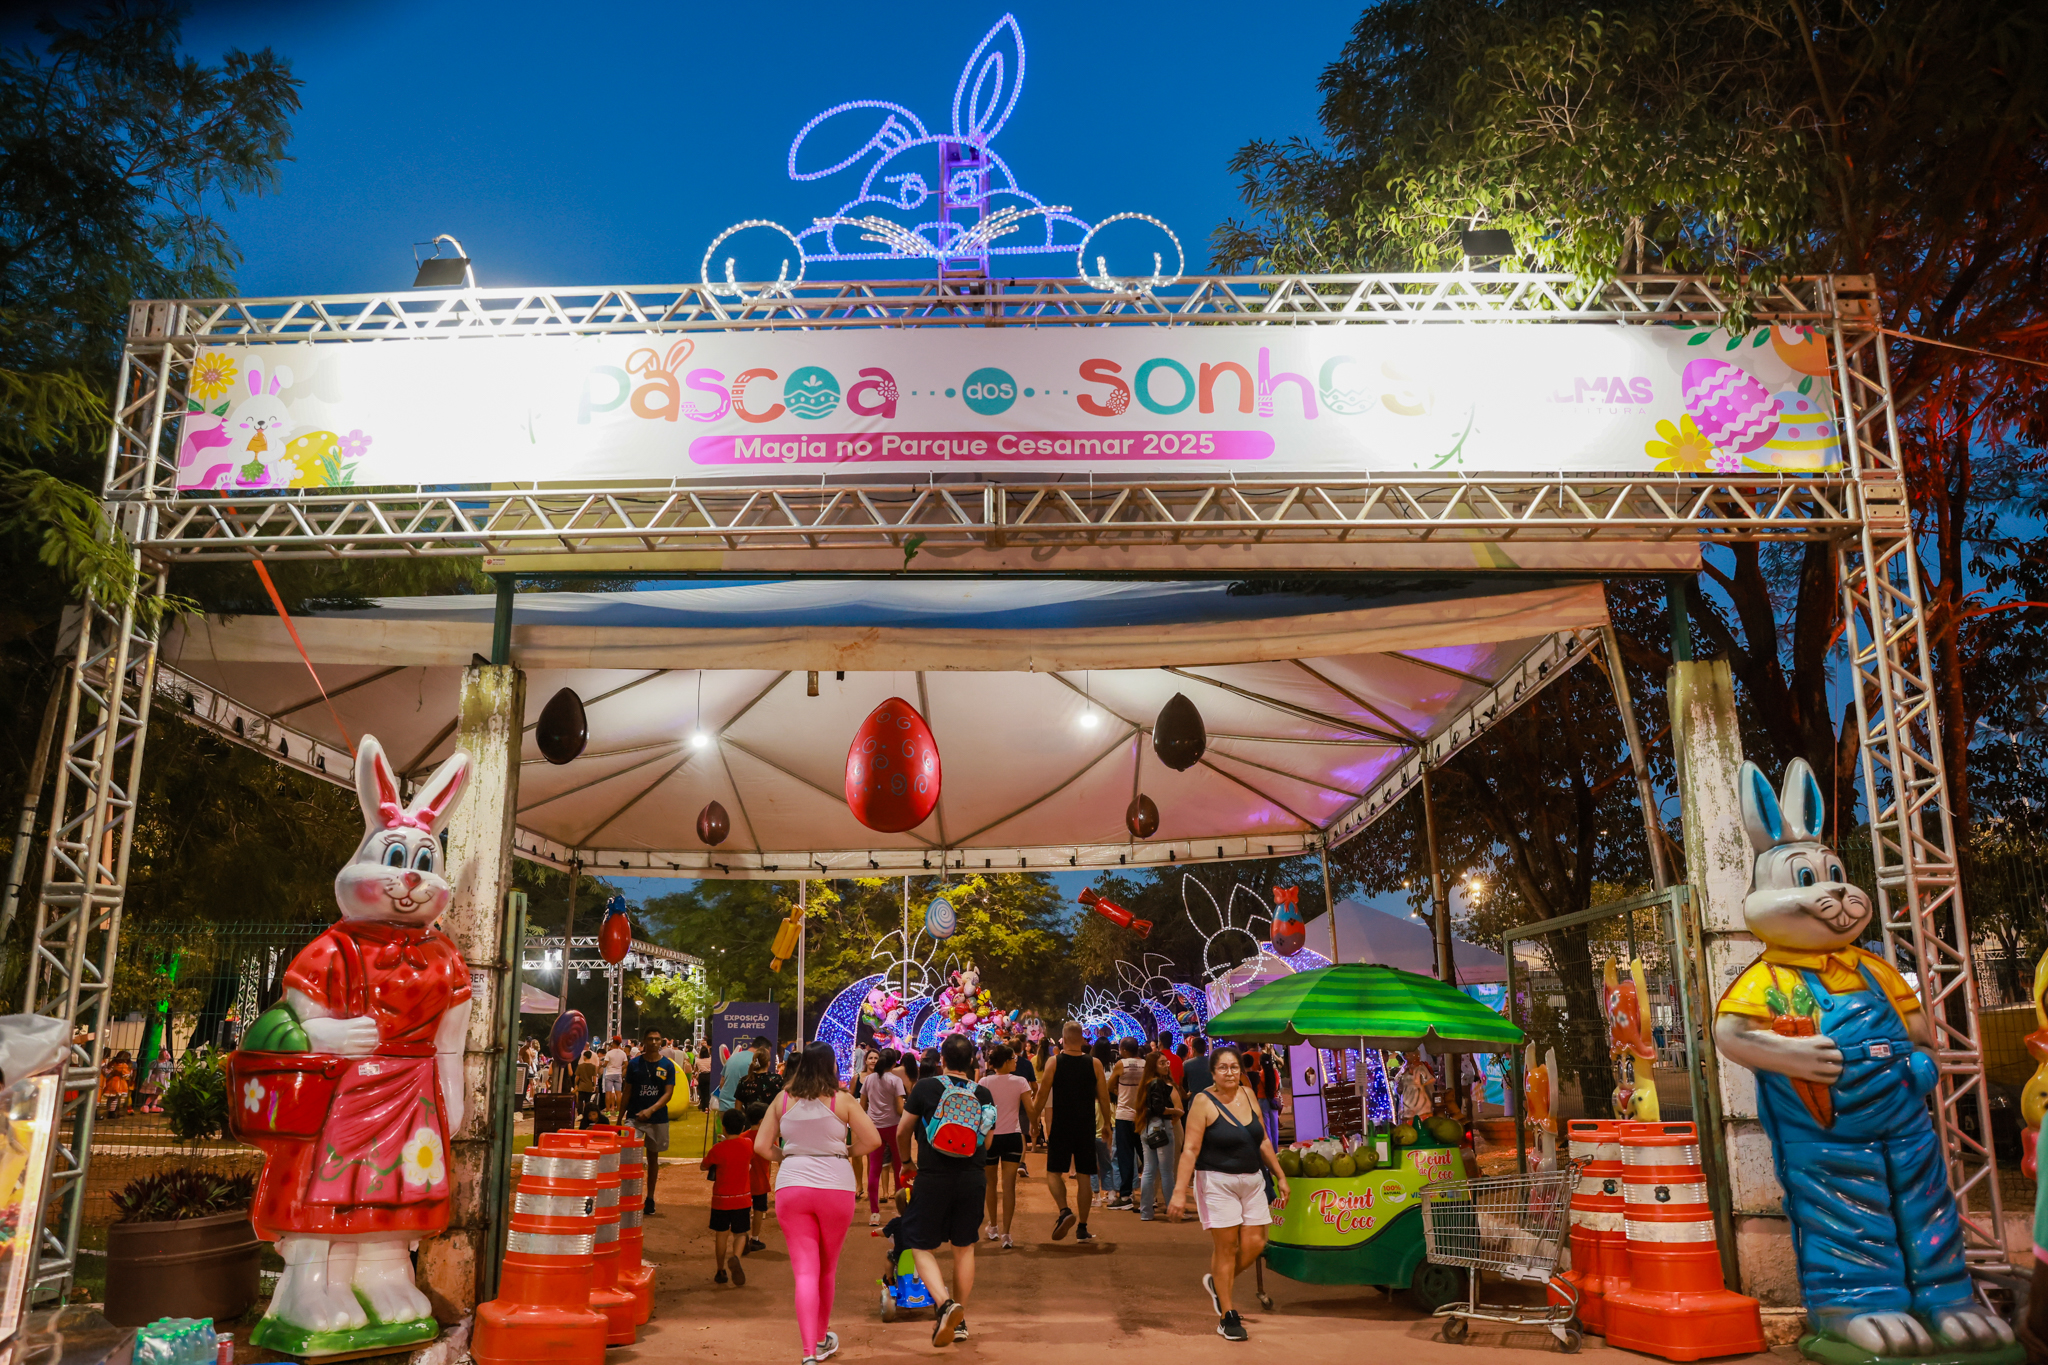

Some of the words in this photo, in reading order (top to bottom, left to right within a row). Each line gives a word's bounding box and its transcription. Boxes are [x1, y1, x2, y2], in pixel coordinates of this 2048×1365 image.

[967, 381, 1013, 400] dos
[1546, 376, 1654, 404] LMAS
[734, 436, 826, 463] Magia
[837, 440, 873, 456] no
[881, 435, 988, 460] Parque
[997, 434, 1134, 455] Cesamar
[1143, 433, 1216, 455] 2025
[724, 1013, 770, 1023] EXPOSIÇÃO
[1406, 1148, 1453, 1170] Point
[1427, 1164, 1454, 1184] Coco
[1310, 1186, 1375, 1216] Point
[1411, 1191, 1422, 1199] VIS
[1336, 1209, 1376, 1234] Coco
